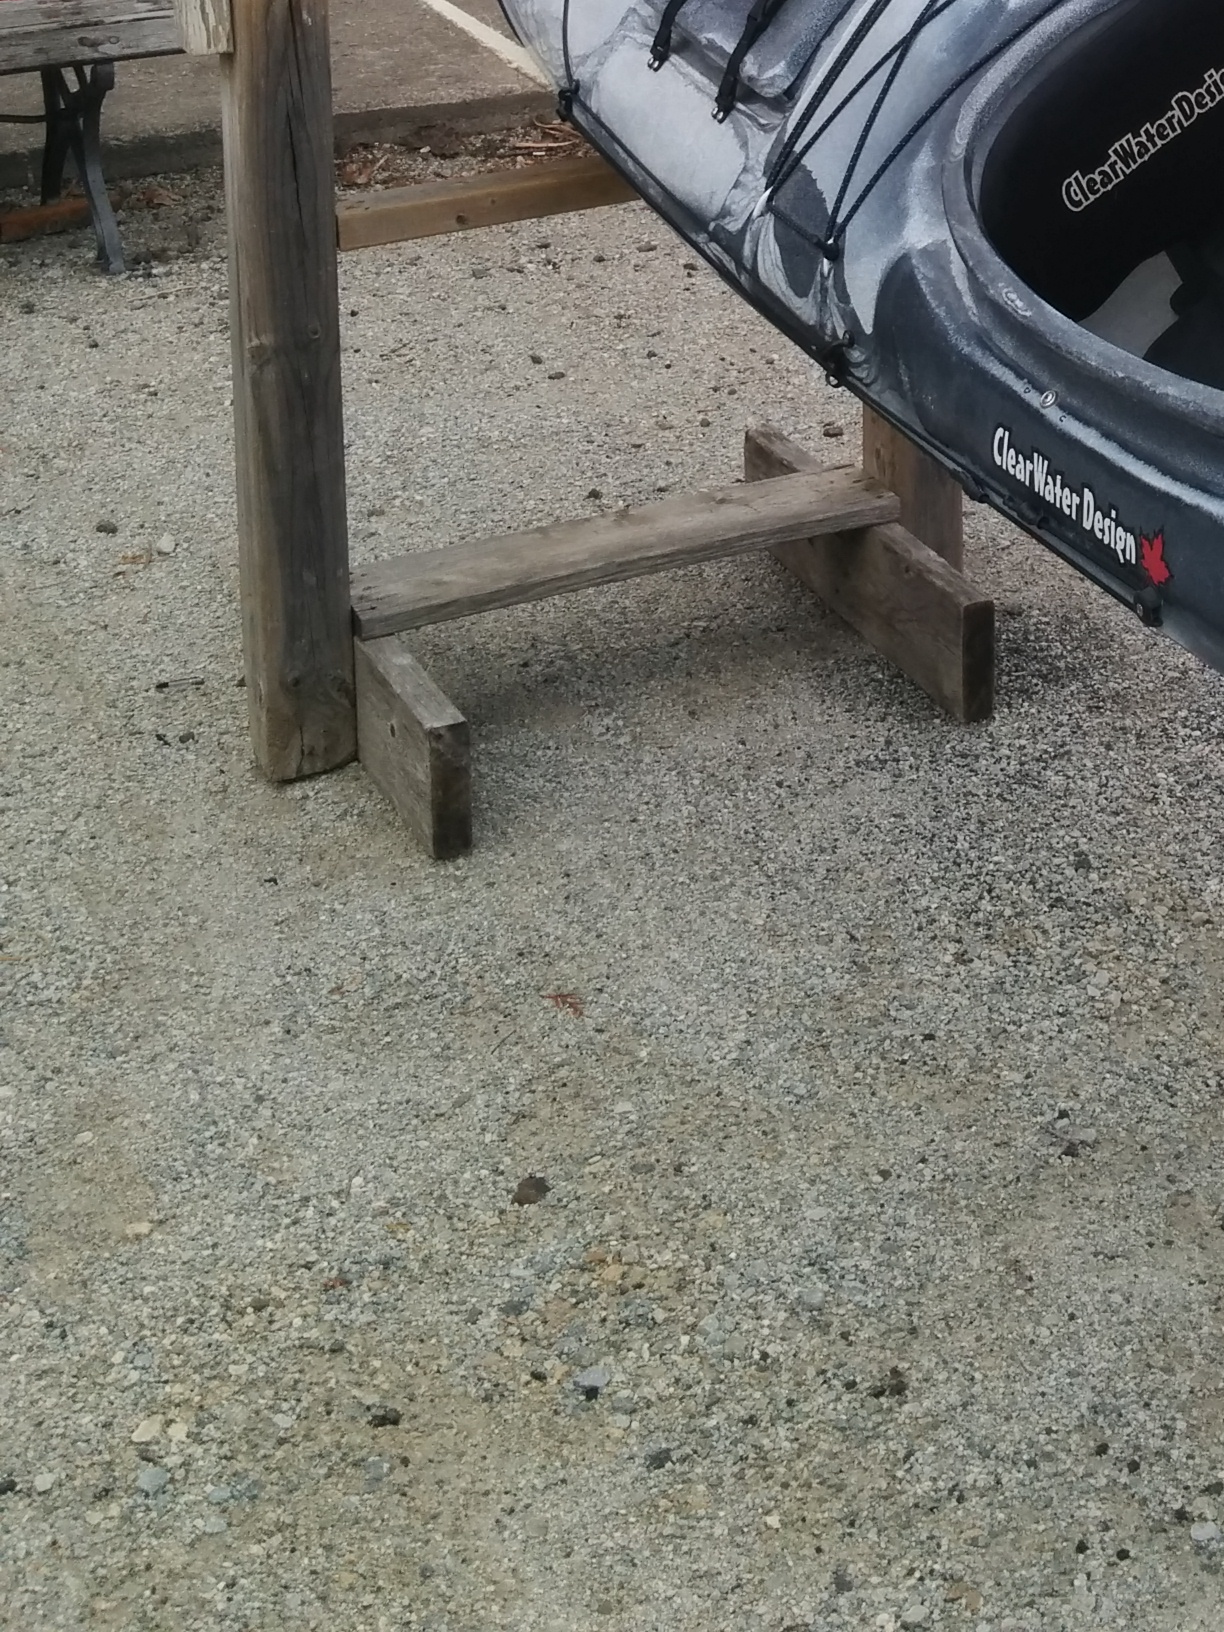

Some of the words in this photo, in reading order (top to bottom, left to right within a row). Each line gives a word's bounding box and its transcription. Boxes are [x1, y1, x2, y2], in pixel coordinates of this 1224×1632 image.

[1062, 110, 1182, 211] ClearWater
[992, 426, 1081, 521] ClearWater
[1082, 487, 1137, 565] Design
